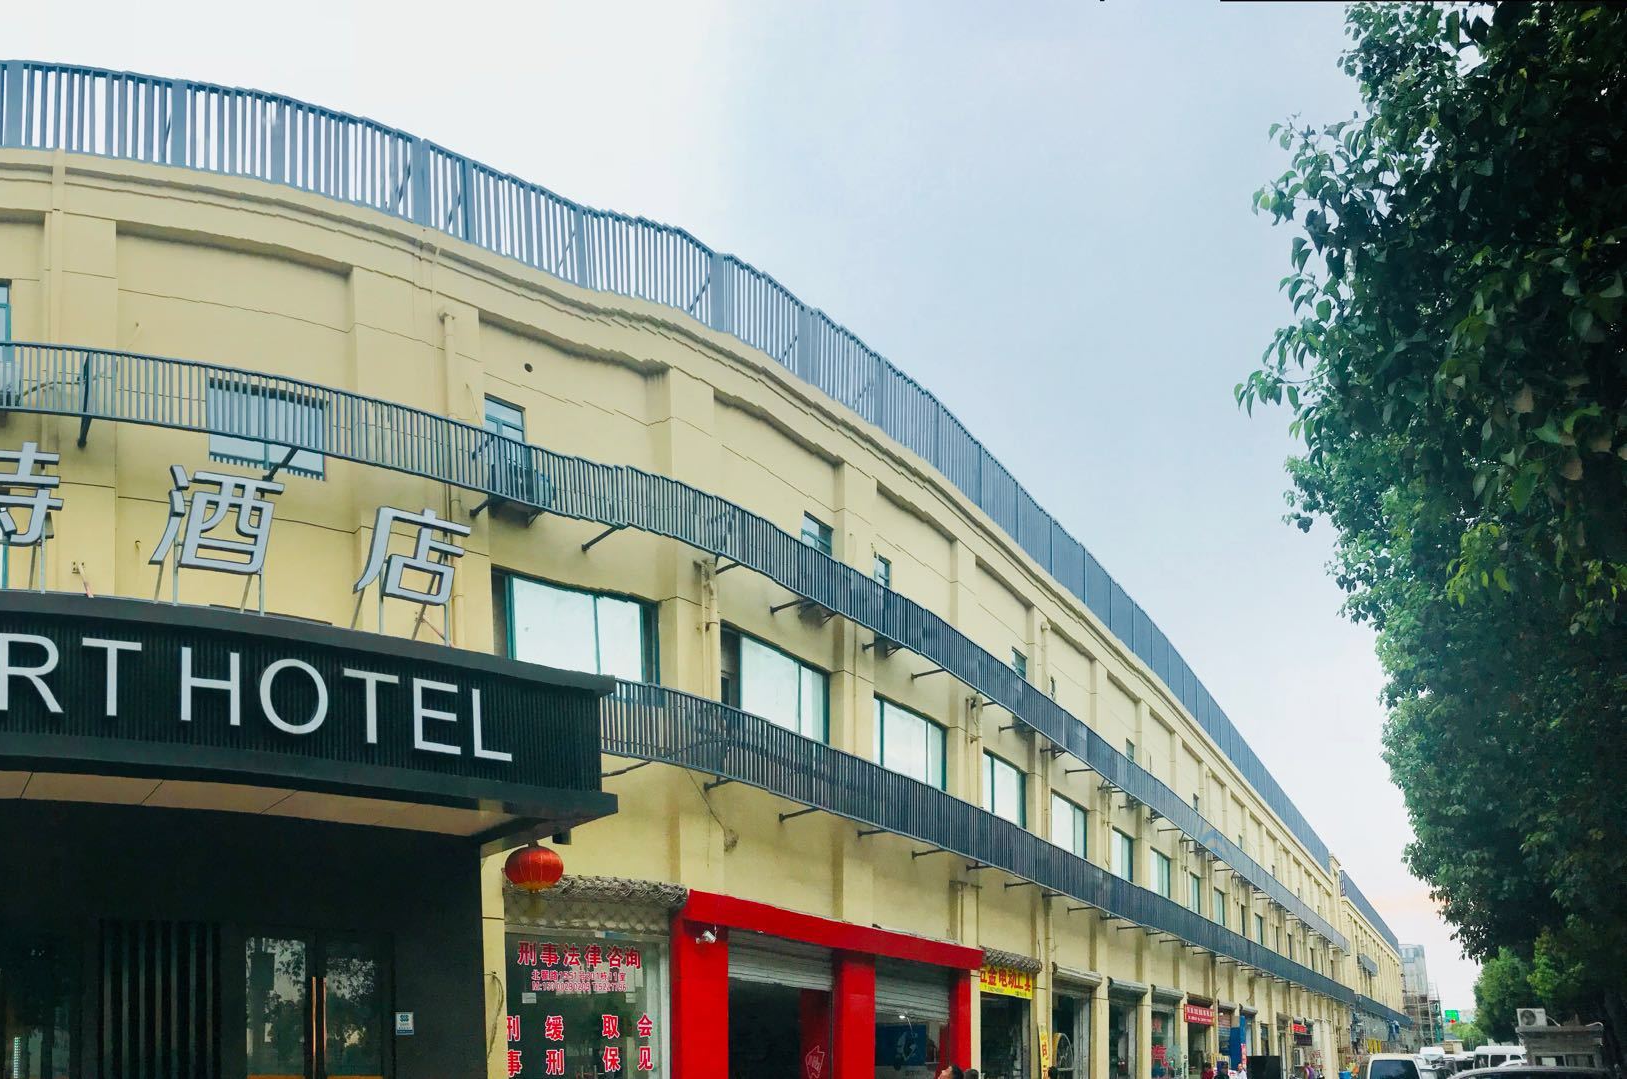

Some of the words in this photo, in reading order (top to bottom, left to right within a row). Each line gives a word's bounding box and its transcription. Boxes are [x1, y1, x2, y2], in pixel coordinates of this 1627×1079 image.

[180, 647, 513, 762] HOTEL
[517, 939, 642, 969] 刑事法律咨询
[545, 1014, 565, 1076] 缓刑
[601, 1013, 620, 1072] 取保
[637, 1012, 653, 1071] 会见
